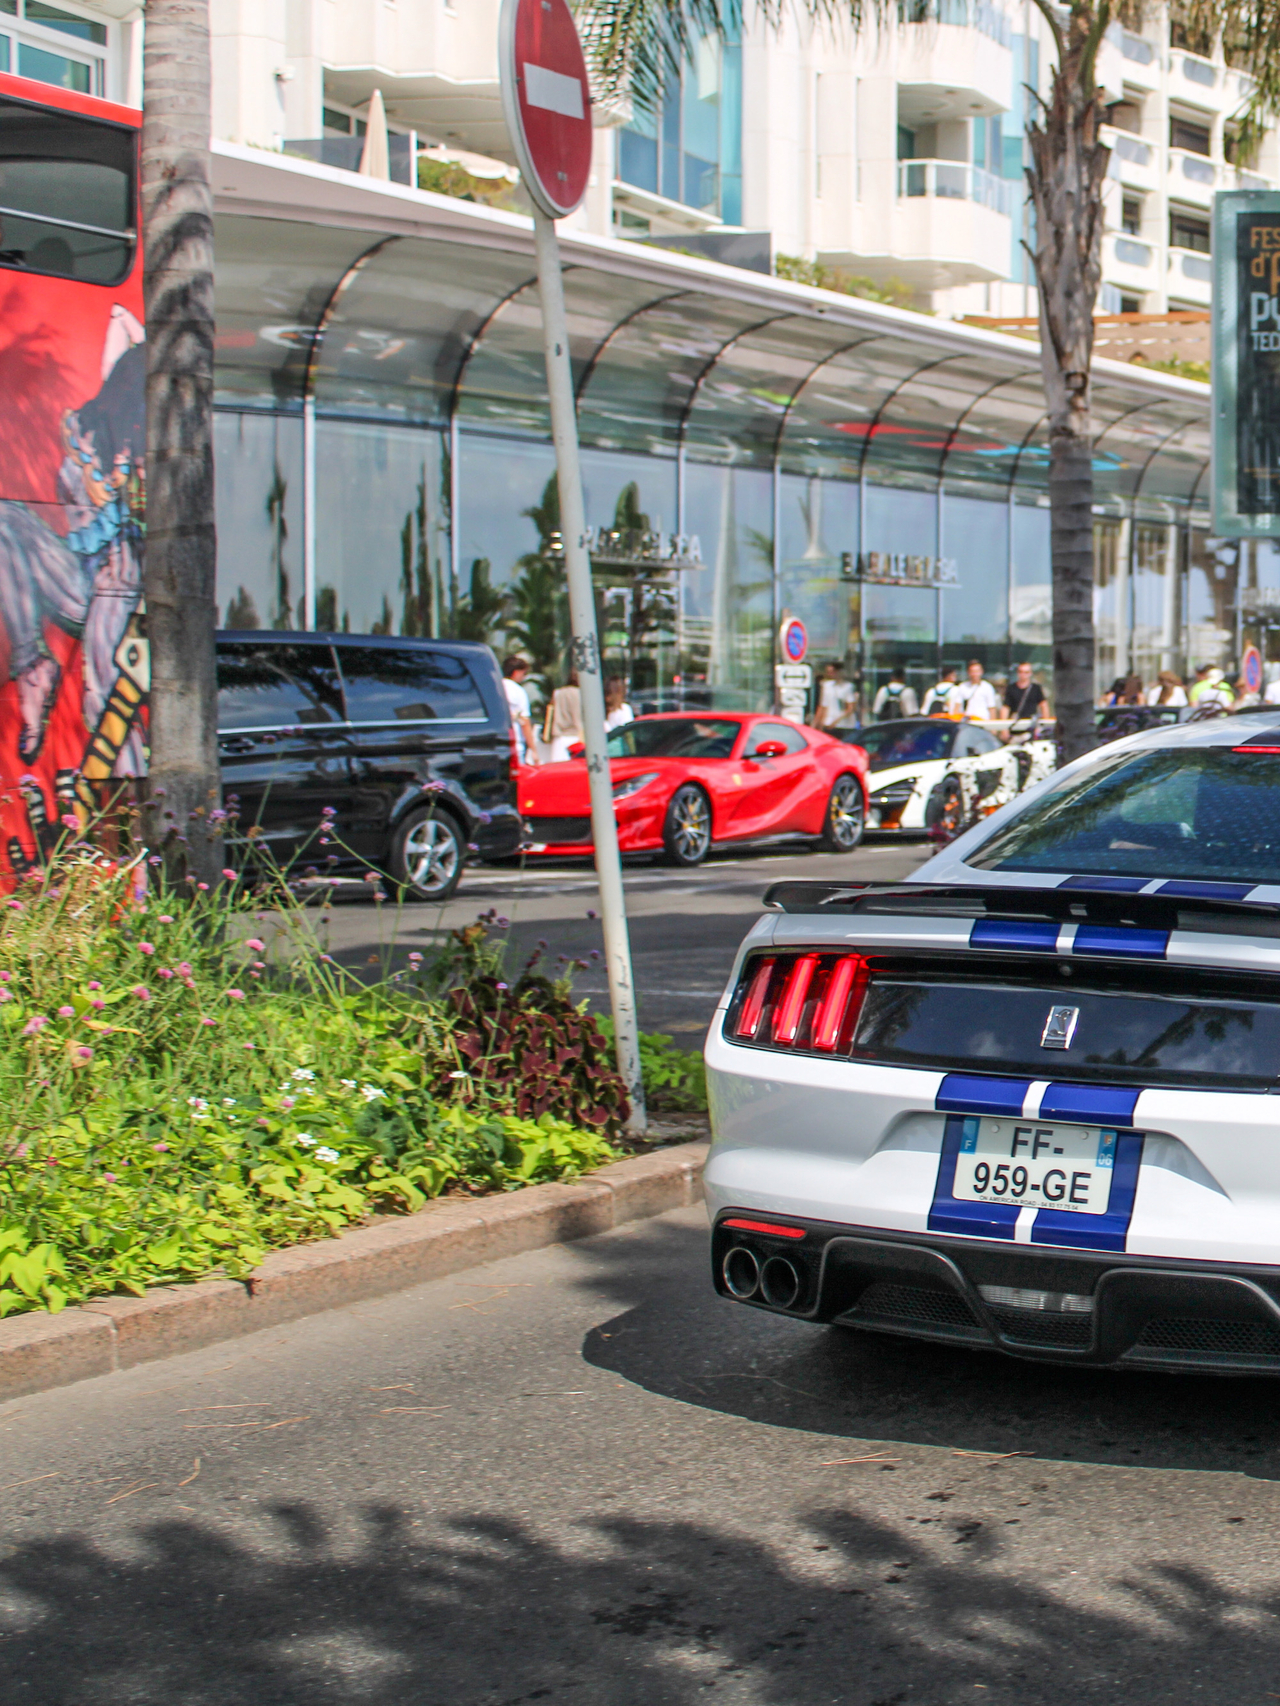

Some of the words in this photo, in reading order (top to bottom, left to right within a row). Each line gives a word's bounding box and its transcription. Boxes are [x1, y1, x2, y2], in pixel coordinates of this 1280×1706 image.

[964, 1140, 973, 1150] F
[1010, 1126, 1064, 1160] FF-
[1098, 1154, 1113, 1166] 06
[973, 1161, 1092, 1204] 959-GE
[989, 1196, 1019, 1204] AMERICAN
